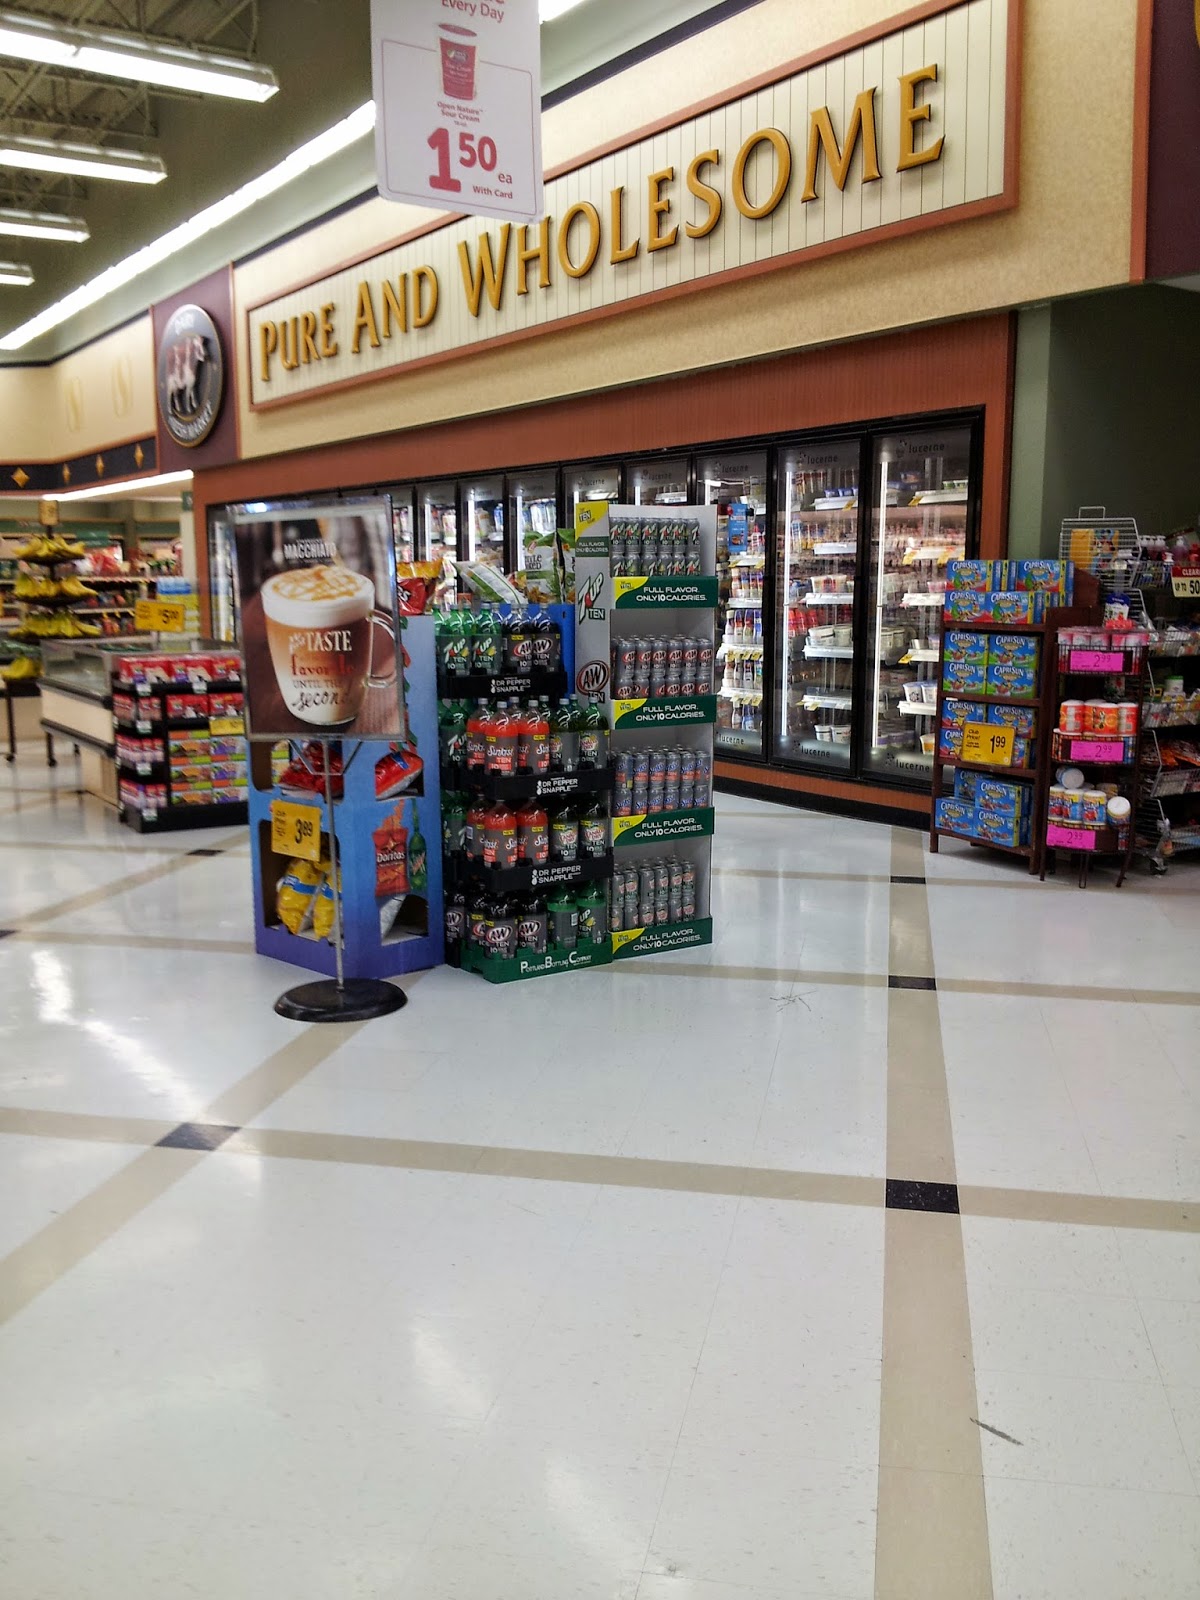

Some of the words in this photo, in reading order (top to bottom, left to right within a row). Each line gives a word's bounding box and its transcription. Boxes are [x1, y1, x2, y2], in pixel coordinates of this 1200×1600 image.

[441, 0, 477, 16] Every
[480, 2, 505, 23] Day
[458, 112, 481, 122] Cream
[498, 172, 513, 184] ea
[473, 185, 493, 196] With
[494, 188, 513, 199] Card
[260, 302, 338, 382] PURE
[351, 264, 439, 354] AND
[457, 62, 946, 318] WHOLESOME
[908, 442, 945, 454] lucerne
[807, 454, 839, 465] lucerne
[577, 572, 604, 625] 7UP
[657, 594, 666, 602] 10
[589, 610, 605, 620] TEN
[307, 630, 352, 651] TASTE
[443, 638, 466, 663] 7UP
[292, 689, 350, 711] secon
[718, 732, 745, 745] lucerne
[990, 735, 1006, 754] 199
[801, 747, 831, 758] lucerne
[895, 757, 930, 772] lucerne
[542, 780, 552, 788] DR
[553, 778, 578, 786] PEPPER
[542, 785, 572, 794] SNAPPLE
[634, 830, 656, 838] ONLY
[376, 851, 405, 863] Doritos
[538, 868, 550, 876] DR
[551, 865, 582, 875] PEPPER
[538, 873, 574, 884] SNAPPLE
[640, 934, 661, 942] FULL
[633, 943, 654, 951] ONLY
